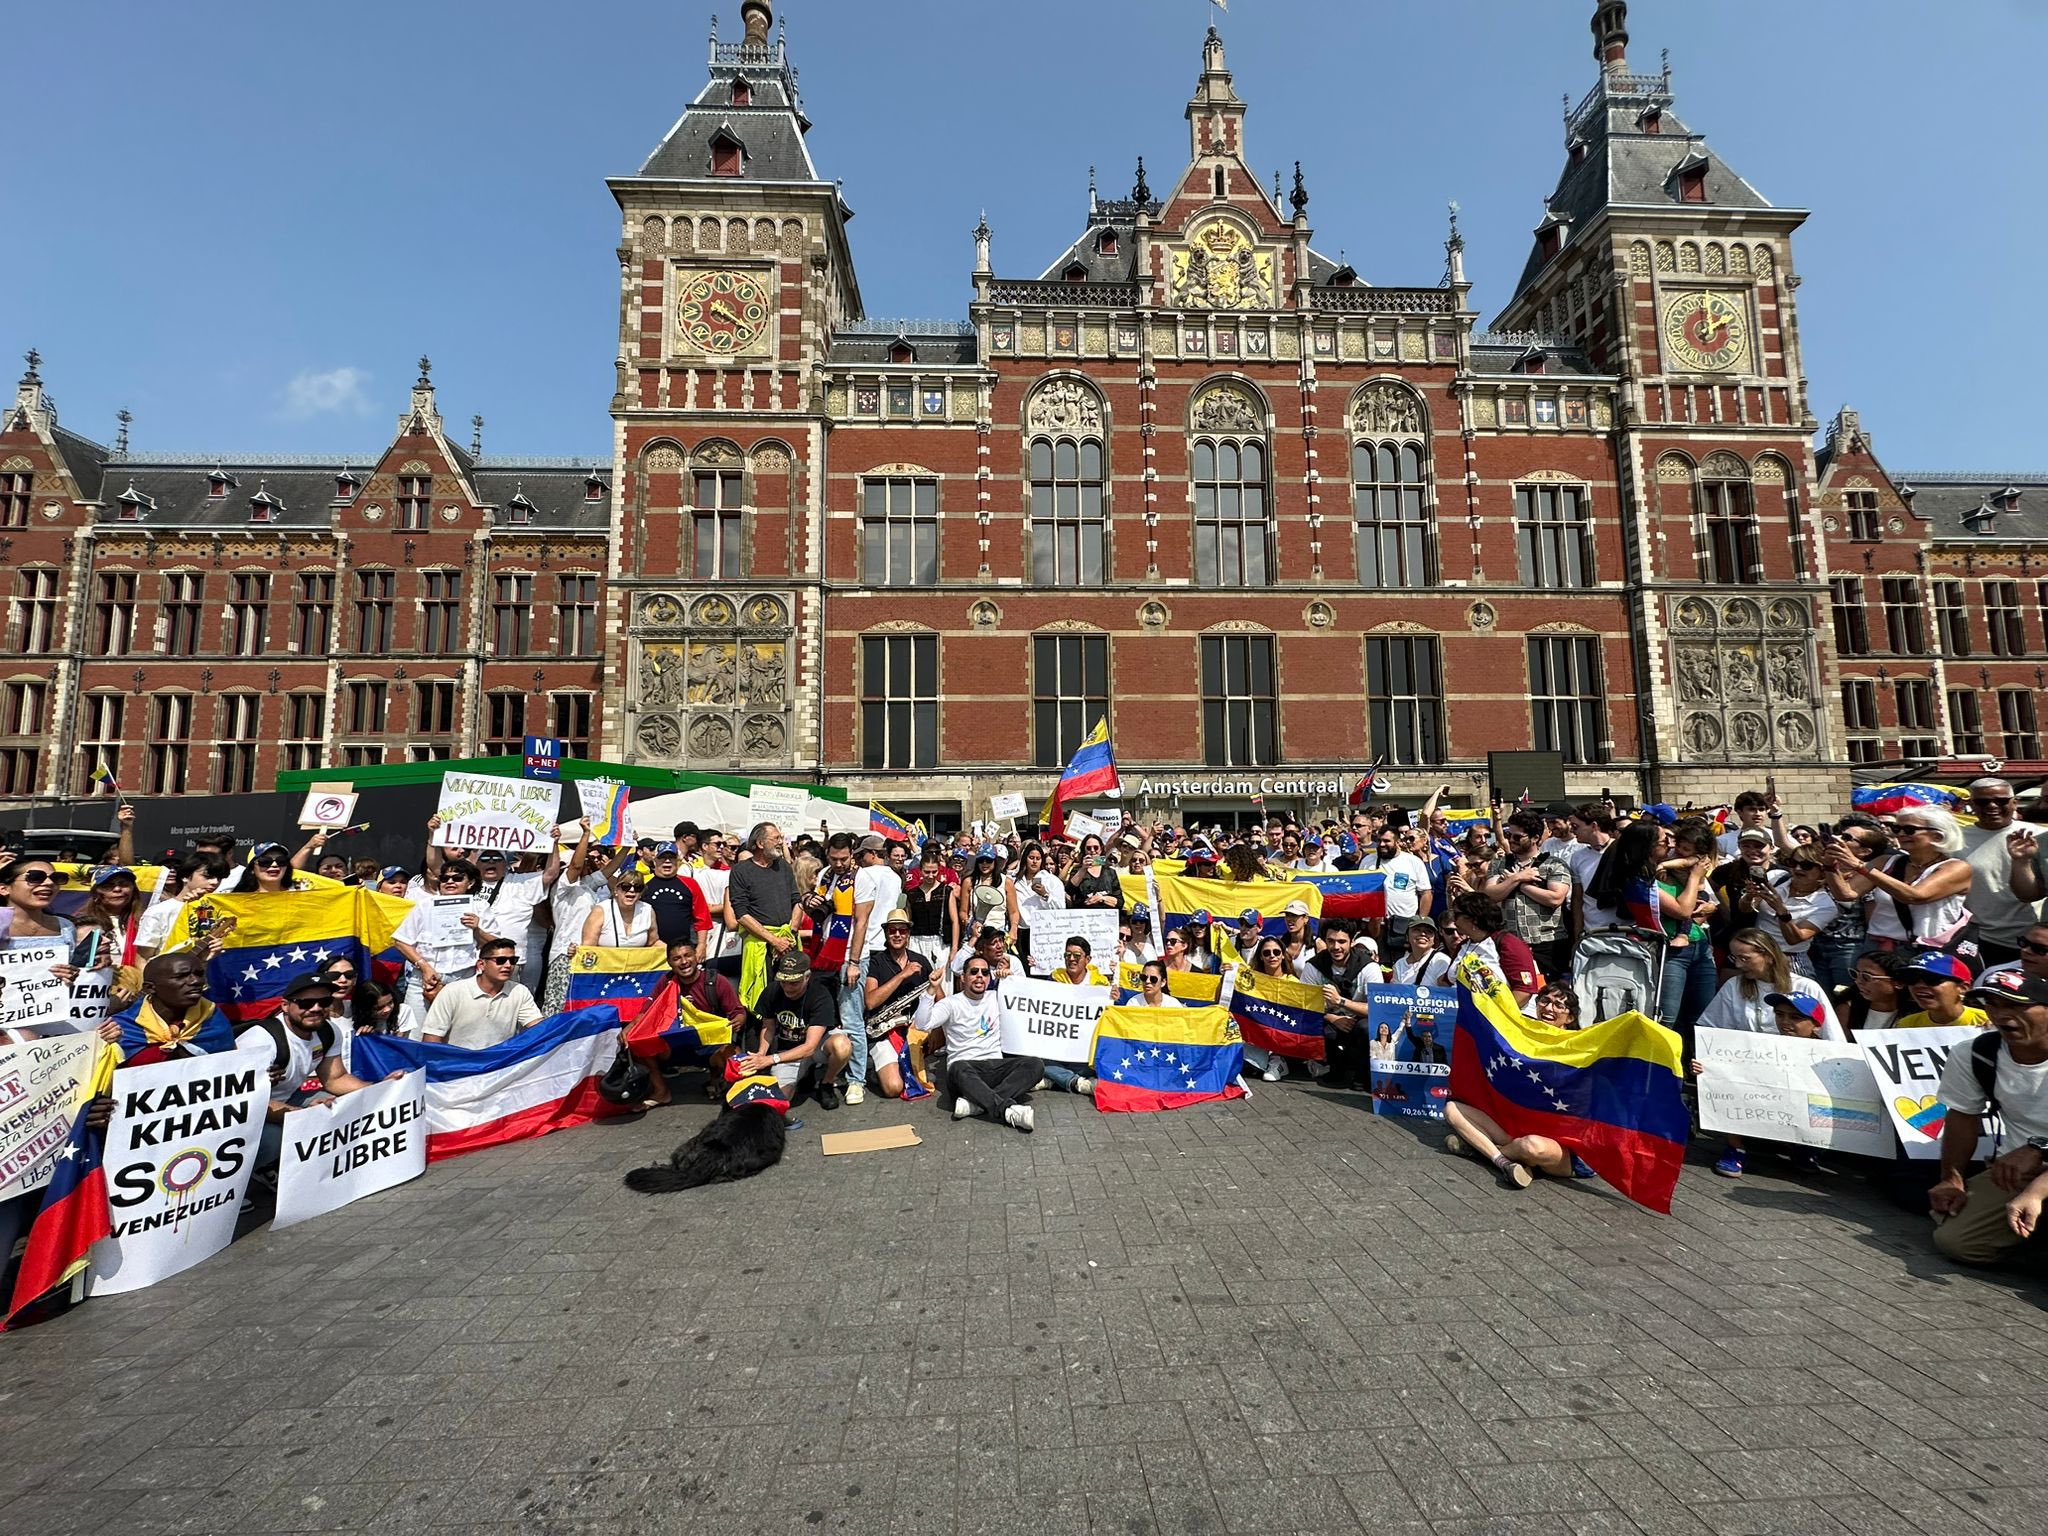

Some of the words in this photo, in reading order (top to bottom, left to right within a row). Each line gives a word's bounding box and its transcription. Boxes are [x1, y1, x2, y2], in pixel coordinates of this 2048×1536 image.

[717, 276, 731, 290] N
[535, 738, 552, 756] M
[520, 784, 553, 802] LIBRE
[1138, 778, 1253, 794] Amsterdam
[1260, 777, 1345, 794] Centraal
[490, 798, 508, 812] EL
[510, 800, 551, 835] FINAL
[11, 978, 62, 993] FUERZA
[22, 991, 36, 1005] A
[1004, 994, 1104, 1021] VENEZUELA
[1373, 995, 1414, 1006] CIFRAS
[70, 1005, 108, 1019] ACT
[1408, 1005, 1445, 1015] EXTERIOR
[1027, 1017, 1080, 1040] LIBRE
[27, 1042, 66, 1064] Paz
[1700, 1034, 1788, 1064] Venezuela
[29, 1043, 90, 1086] Esperanza
[1406, 1063, 1449, 1075] 94.17%
[125, 1069, 256, 1119] KARIM
[1743, 1093, 1783, 1103] conocer
[129, 1100, 249, 1151] KHAN
[294, 1094, 427, 1163] VENEZUELA
[332, 1129, 407, 1179] LIBRE
[109, 1137, 246, 1208] SOS
[110, 1188, 235, 1239] VENEZUELA
